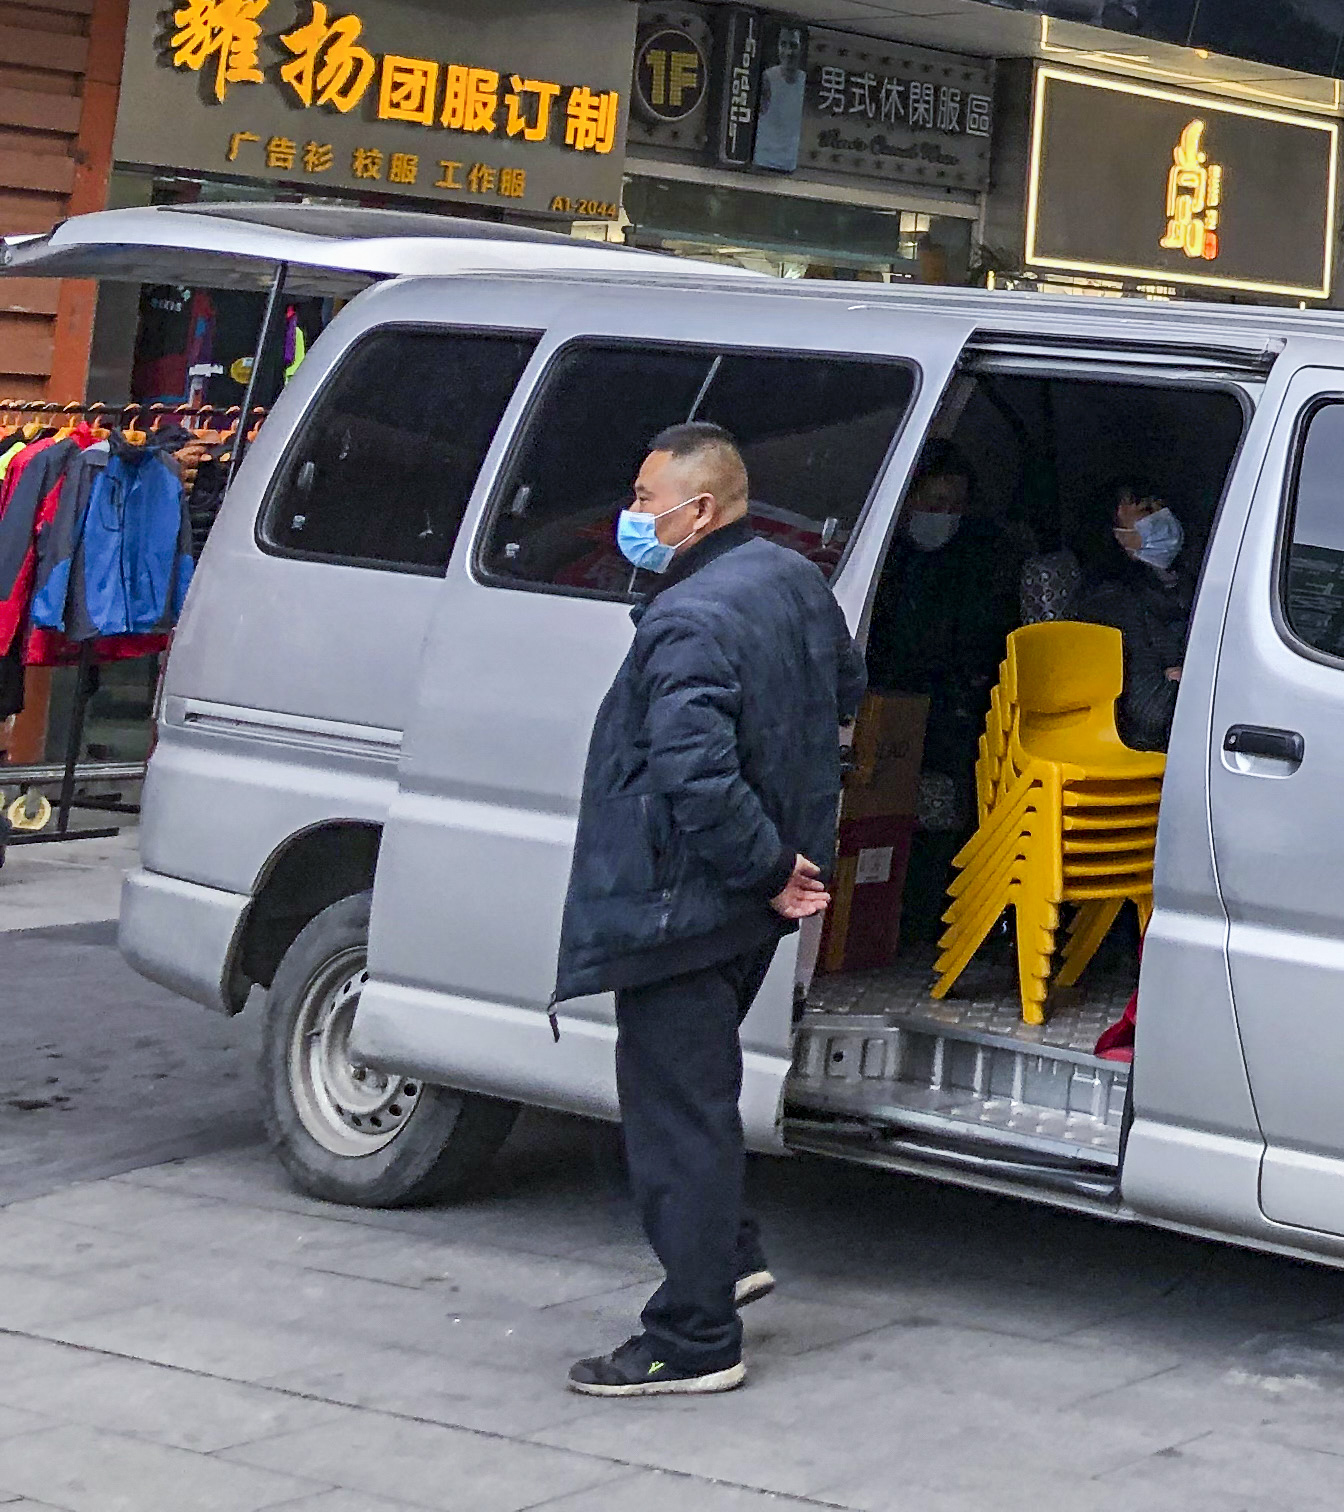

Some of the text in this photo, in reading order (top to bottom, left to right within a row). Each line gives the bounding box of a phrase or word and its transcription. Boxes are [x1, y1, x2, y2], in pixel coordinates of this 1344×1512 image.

[645, 49, 700, 107] 1F
[226, 131, 527, 199] 广告衫 校服 工作服
